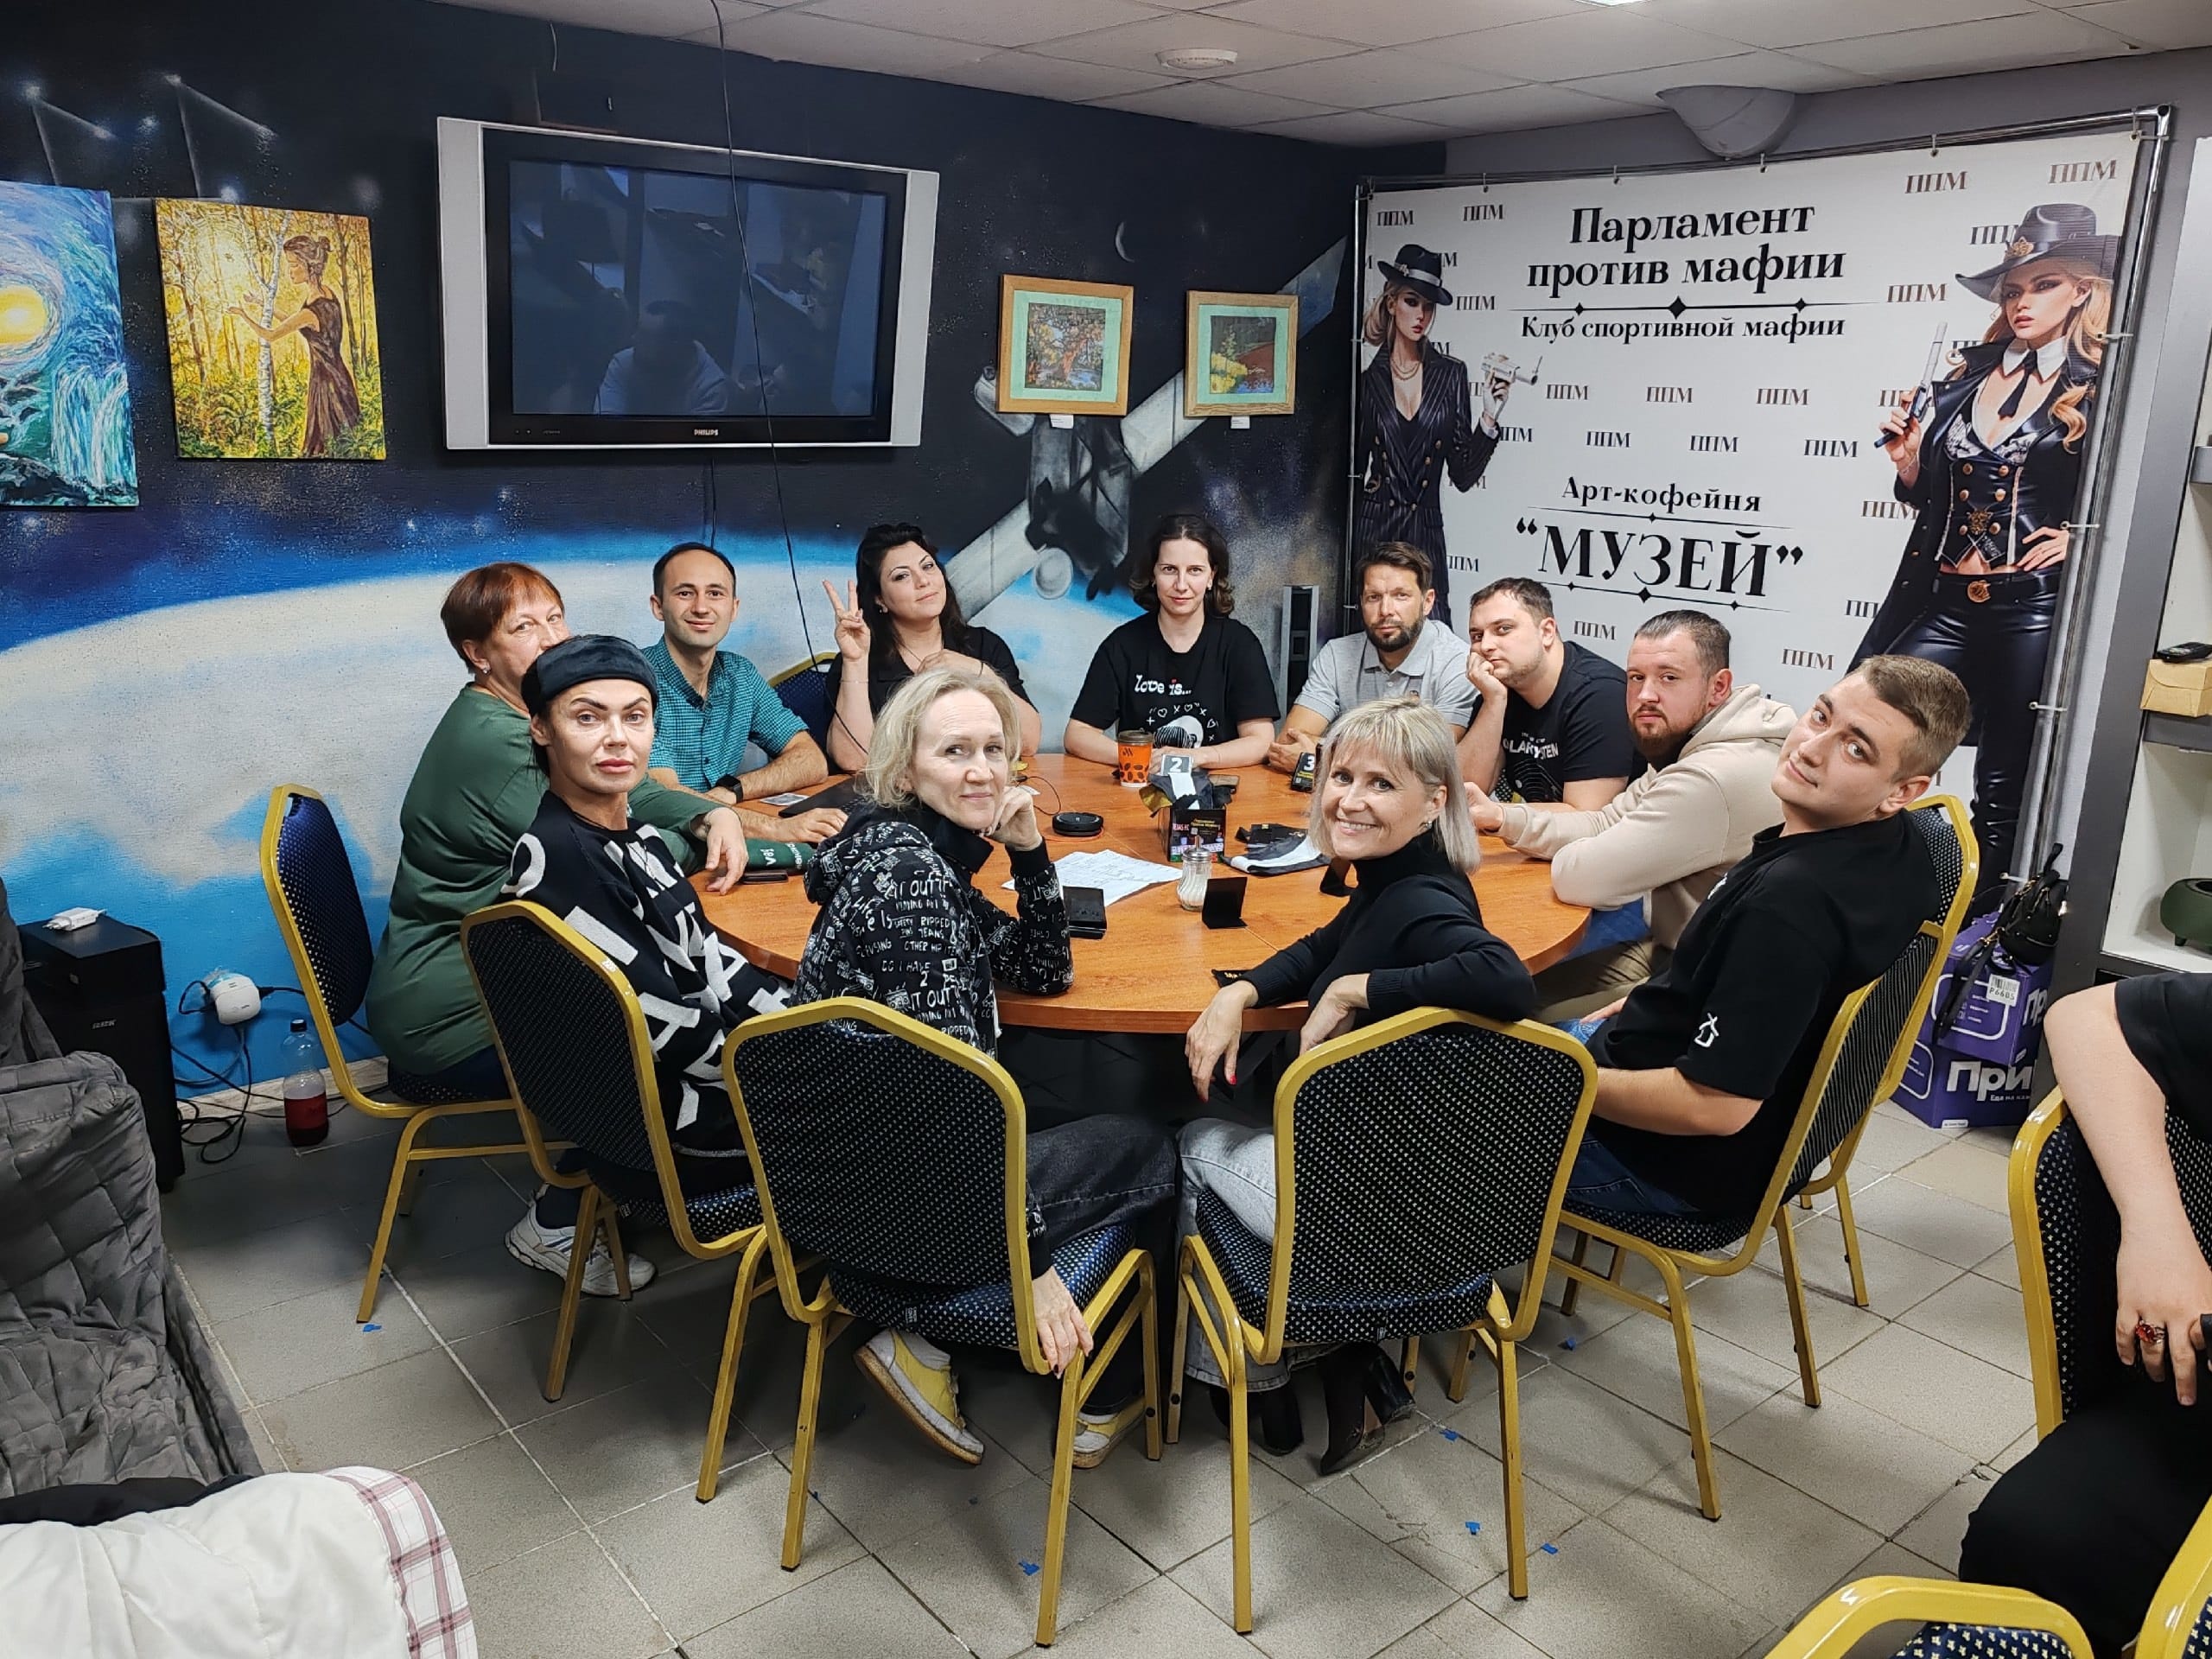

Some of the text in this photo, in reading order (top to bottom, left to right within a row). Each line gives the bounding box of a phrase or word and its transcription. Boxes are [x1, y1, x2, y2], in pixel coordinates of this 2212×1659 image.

[2048, 159, 2117, 184] ППМ
[1904, 171, 1967, 194] ППМ
[1376, 210, 1414, 226] ППМ
[1462, 204, 1504, 222] ППМ
[1569, 205, 1815, 254] Парламент
[1527, 244, 1847, 299] против мафии
[1886, 283, 1947, 303] ППМ
[1456, 295, 1497, 311] ППМ
[1521, 313, 1846, 345] Клуб спортивной мафии
[1546, 384, 1589, 401] ППМ
[1645, 386, 1694, 404] ППМ
[1756, 388, 1809, 407] ППМ
[1586, 431, 1631, 448] ППМ
[1689, 435, 1739, 453] ППМ
[1803, 439, 1859, 458] ППМ
[1561, 476, 1762, 514] Арт-кофейня
[1573, 620, 1617, 641] ППМ
[1781, 648, 1834, 671] ППМ
[1169, 757, 1183, 772] 2
[1303, 755, 1315, 771] 3
[920, 916, 950, 929] RIPPED
[904, 940, 929, 951] OTHER
[906, 960, 932, 972] HAVE
